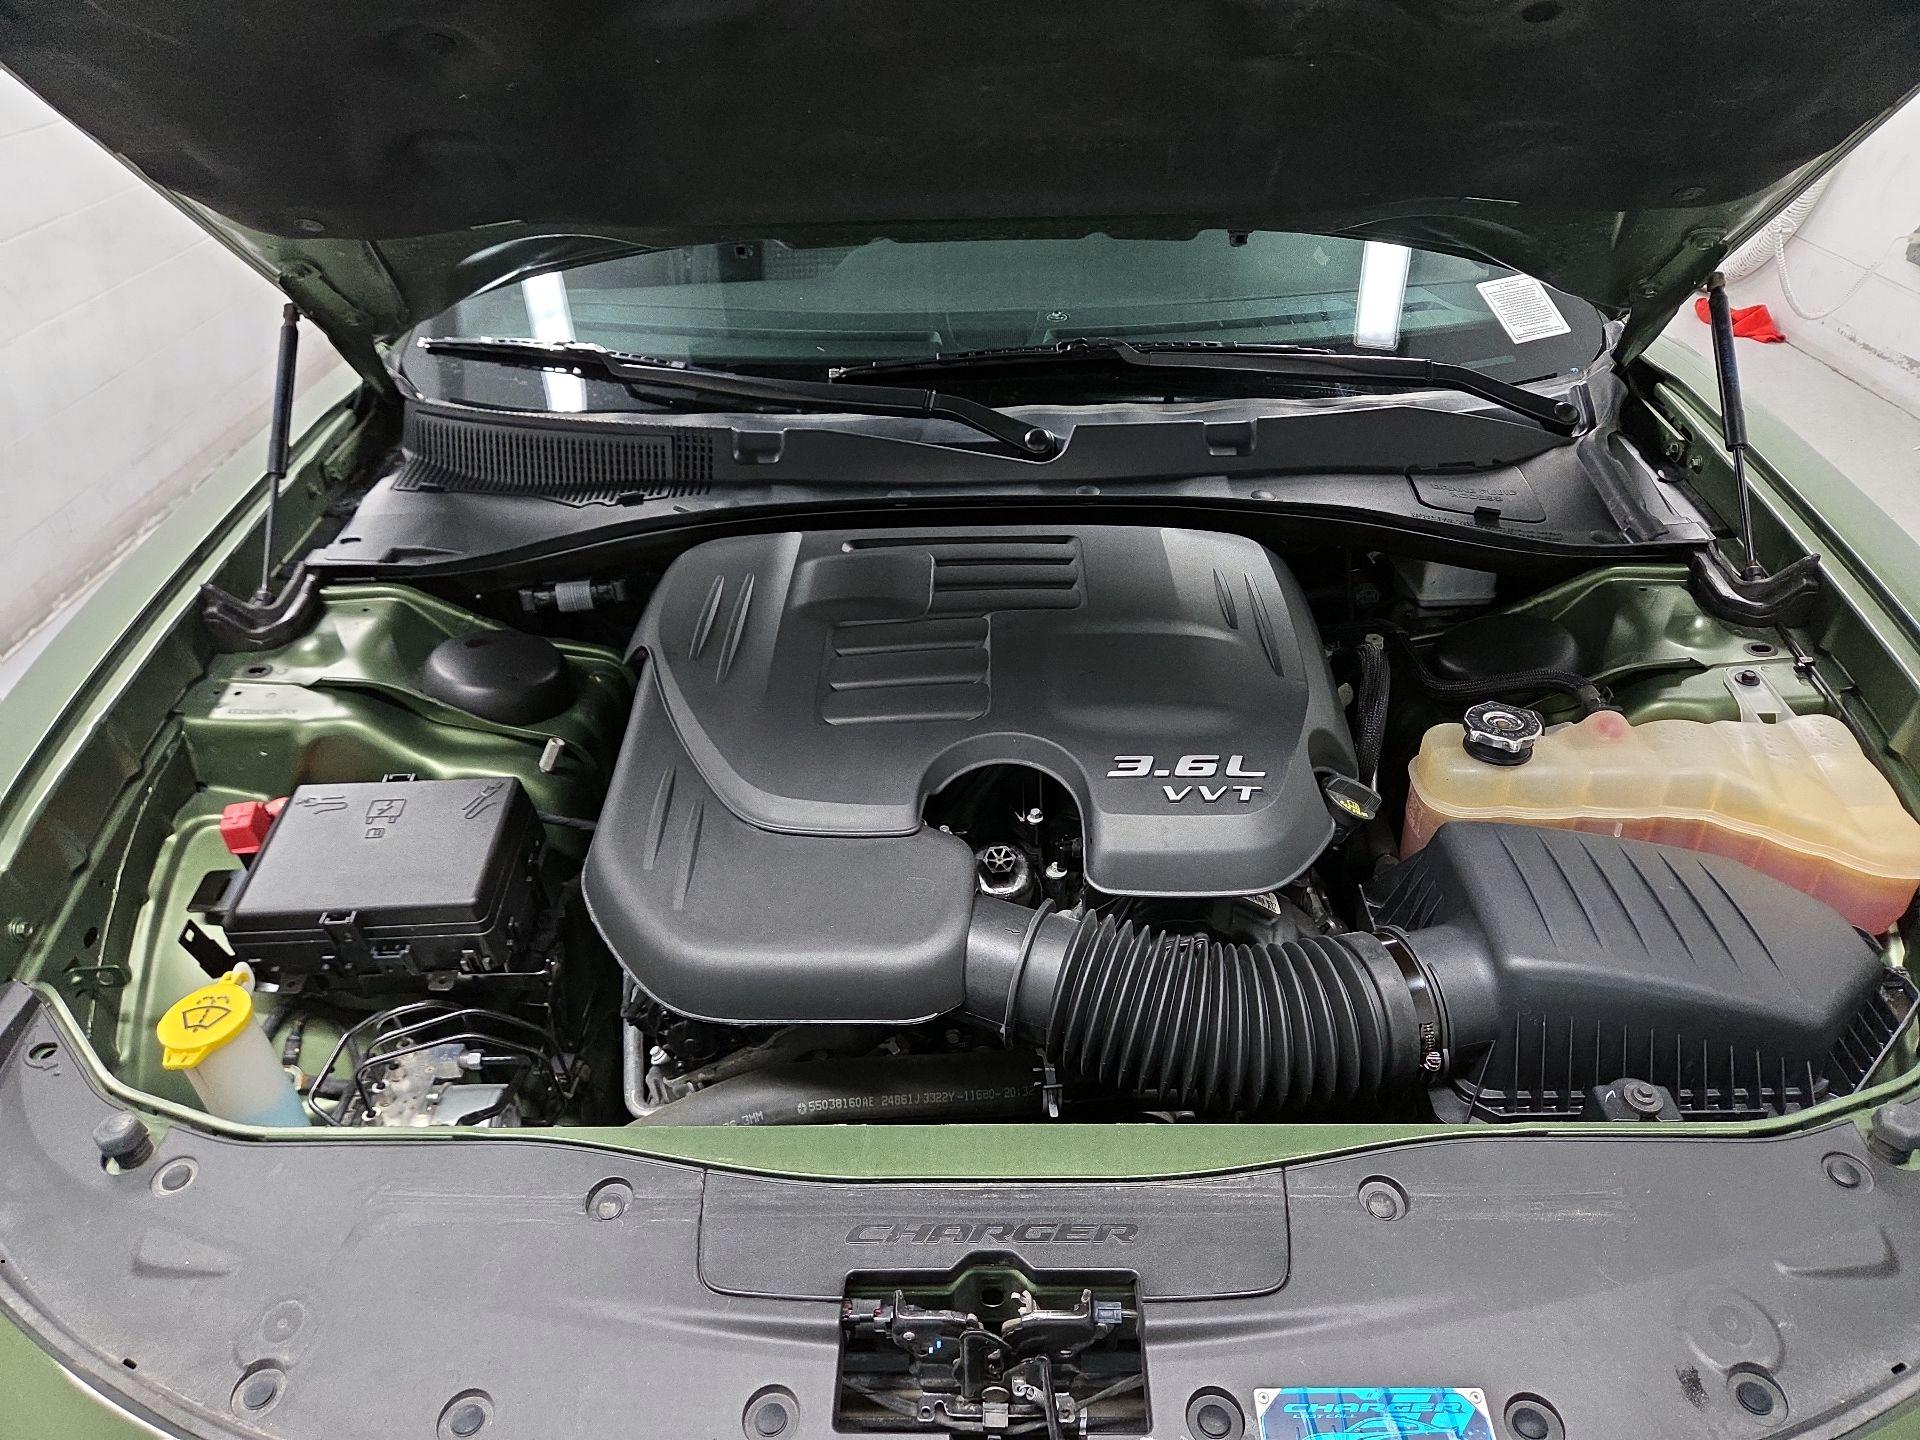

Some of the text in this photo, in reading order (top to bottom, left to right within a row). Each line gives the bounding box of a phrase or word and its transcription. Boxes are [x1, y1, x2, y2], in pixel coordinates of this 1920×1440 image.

[1107, 754, 1266, 778] 3.6L
[1163, 785, 1264, 802] VVT
[845, 1223, 1139, 1245] CHARGER
[1283, 1402, 1466, 1414] CHARGER
